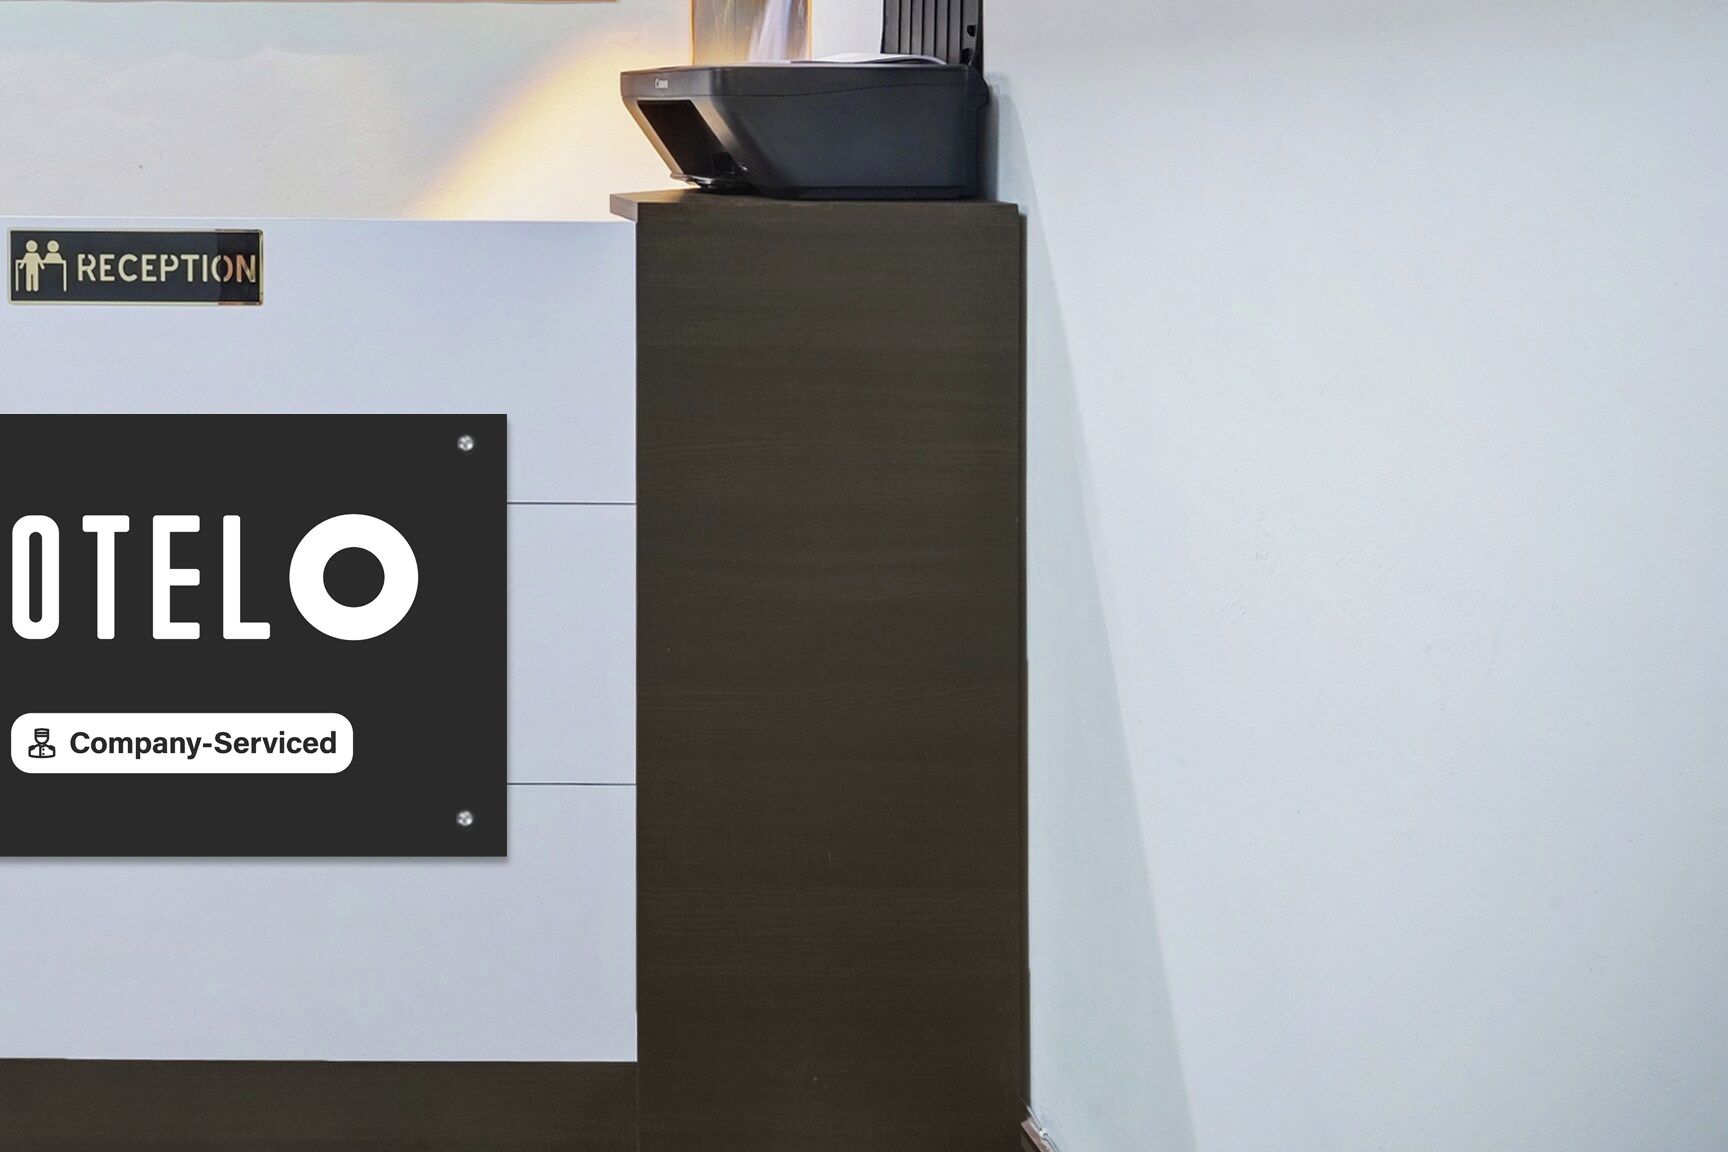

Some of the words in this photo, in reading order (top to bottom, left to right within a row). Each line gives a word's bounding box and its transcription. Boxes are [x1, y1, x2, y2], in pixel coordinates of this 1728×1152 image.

[77, 253, 257, 283] RECEPTION
[288, 513, 419, 641] O
[69, 730, 337, 760] Company-Serviced
